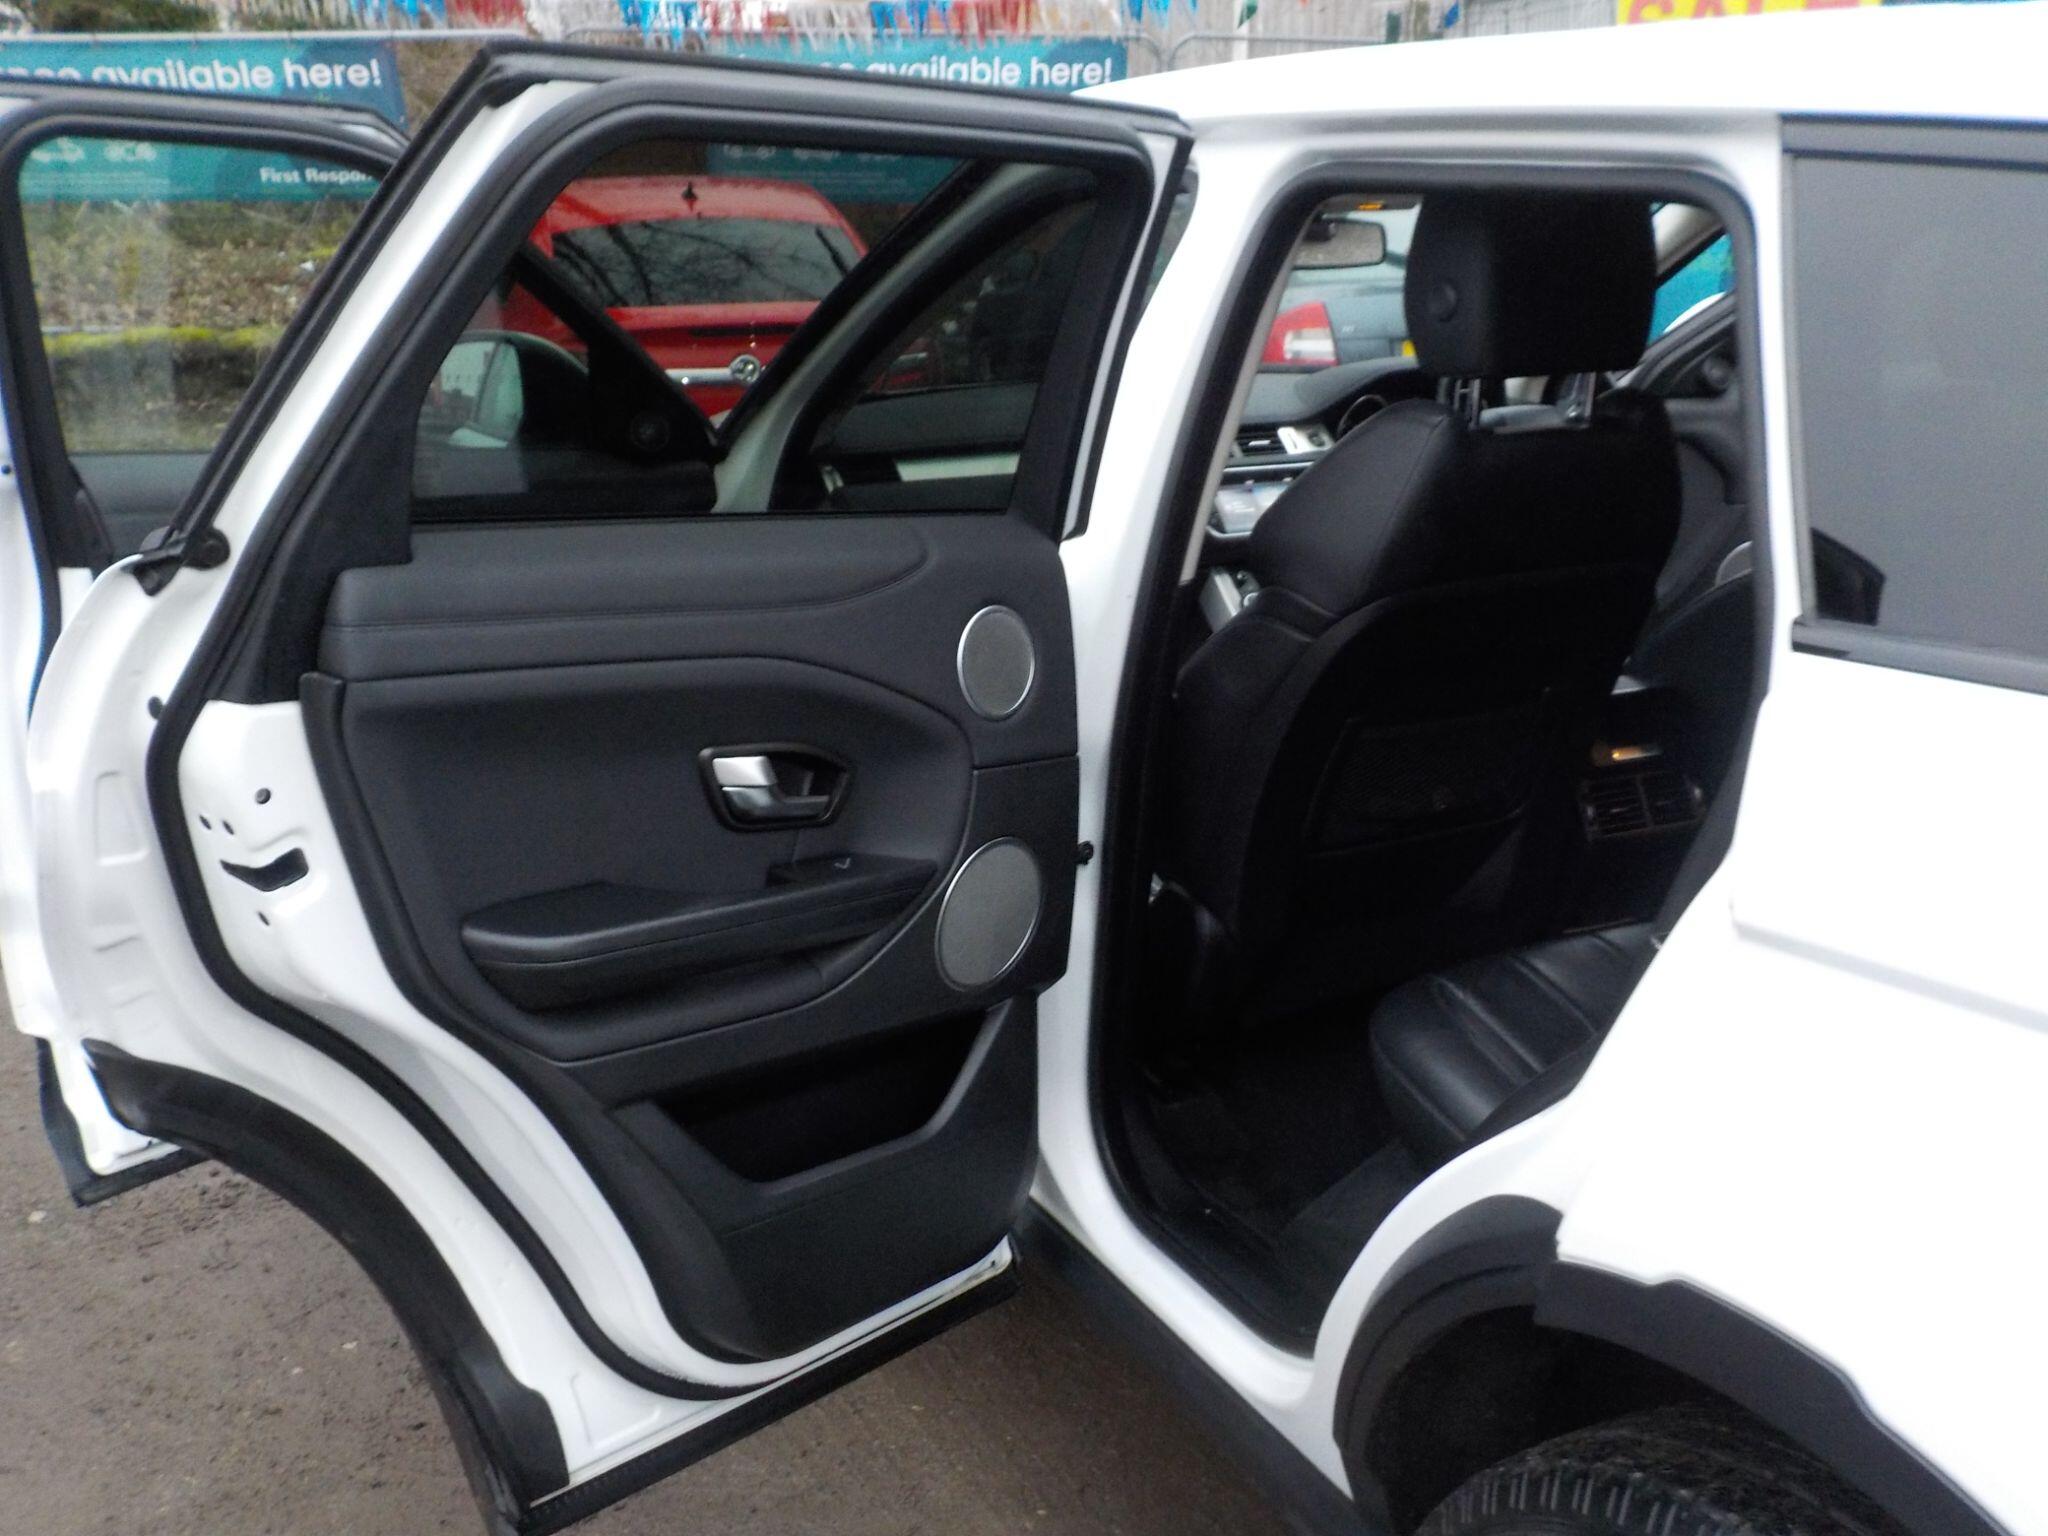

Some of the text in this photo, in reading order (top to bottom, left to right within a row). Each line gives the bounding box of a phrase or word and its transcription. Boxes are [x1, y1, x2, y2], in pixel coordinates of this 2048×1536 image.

[282, 57, 382, 89] here!
[1030, 56, 1113, 87] here!
[260, 166, 300, 183] First
